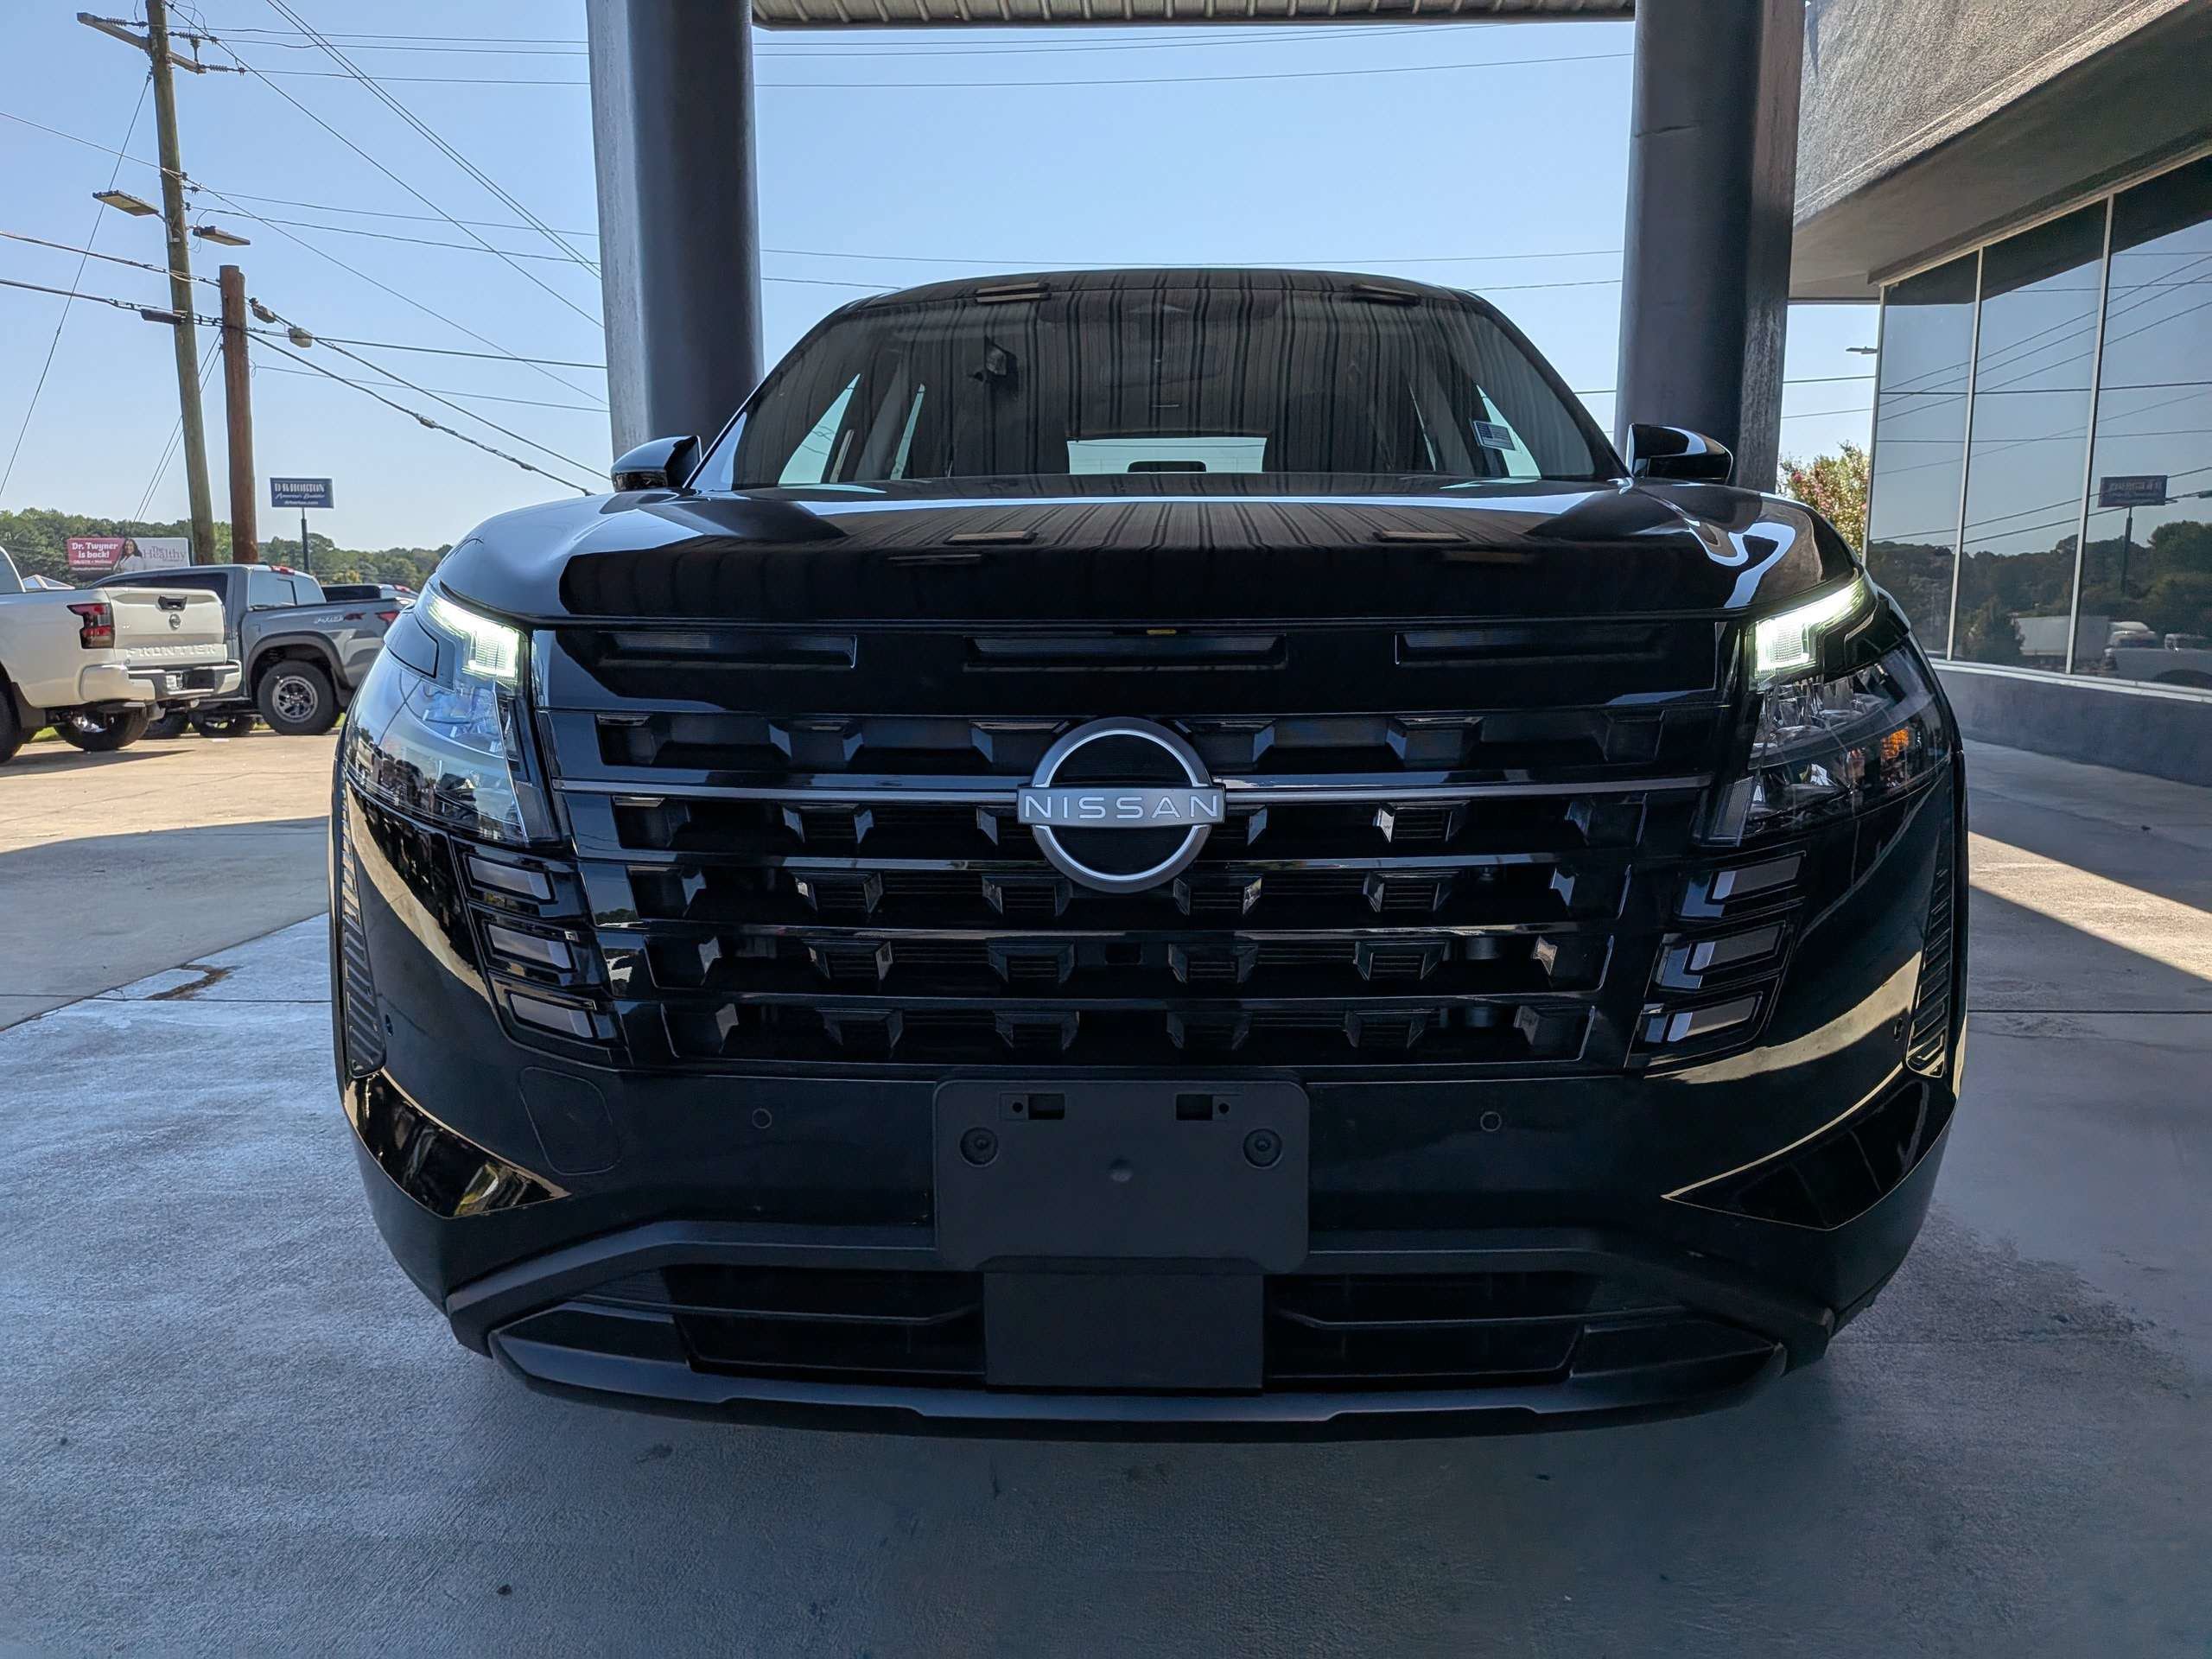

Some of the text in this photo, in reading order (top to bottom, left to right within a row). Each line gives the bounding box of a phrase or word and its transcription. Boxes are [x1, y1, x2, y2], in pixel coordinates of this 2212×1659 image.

[86, 542, 118, 550] Twyner
[143, 547, 186, 561] Healthy
[125, 644, 215, 658] FRONTIER
[1025, 795, 1217, 819] NISSAN
